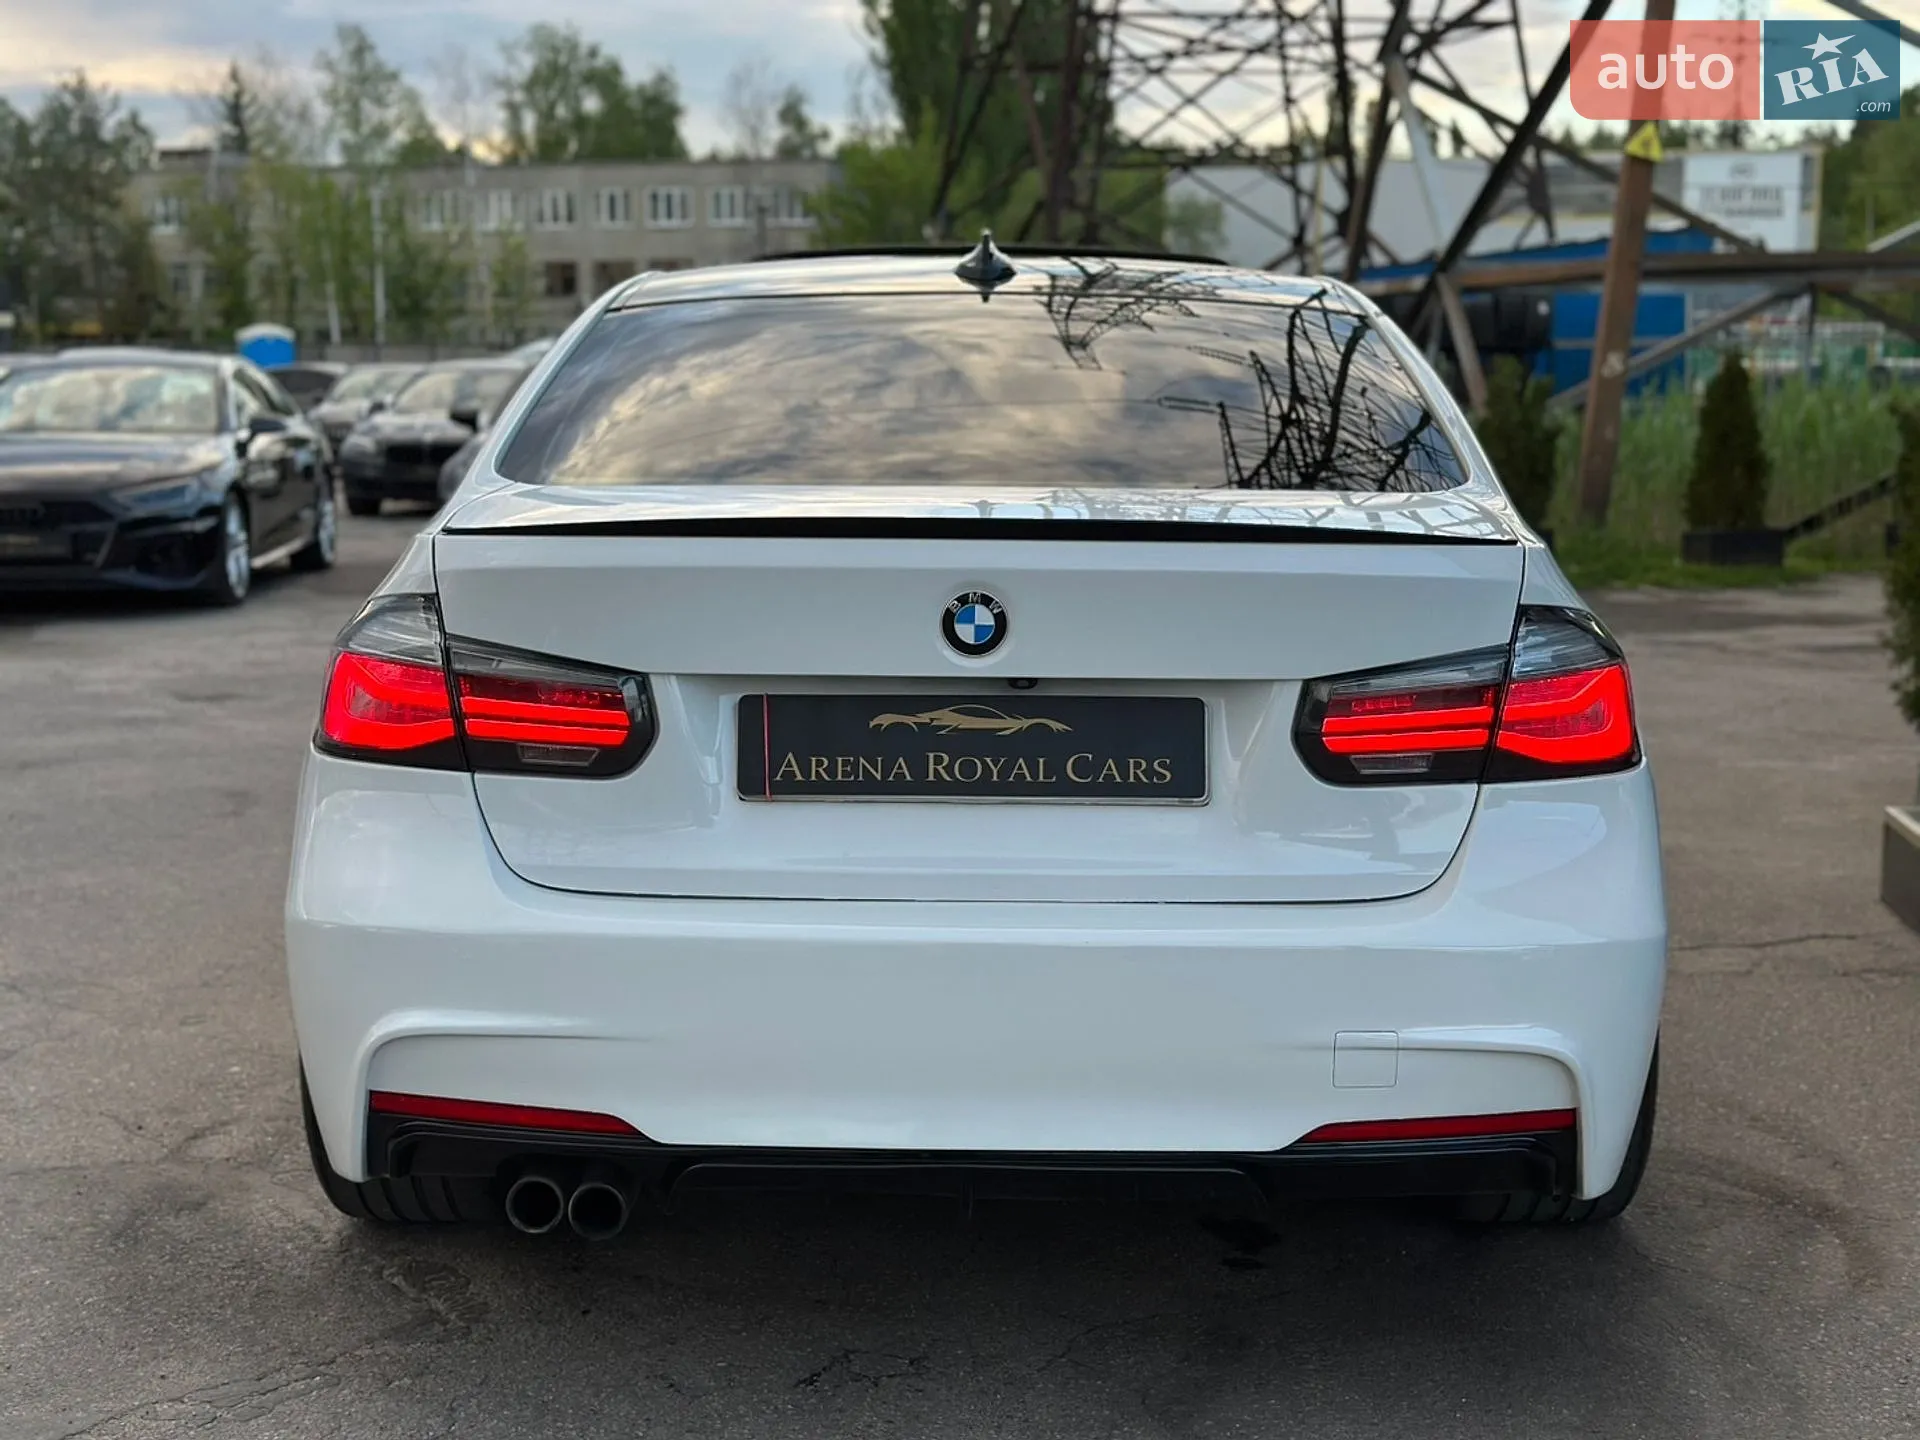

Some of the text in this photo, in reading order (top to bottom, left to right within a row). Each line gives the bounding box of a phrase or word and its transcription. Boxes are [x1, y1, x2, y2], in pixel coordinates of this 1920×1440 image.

[948, 592, 1002, 614] BMW
[774, 751, 1172, 785] ARENA ROYAL CARS
